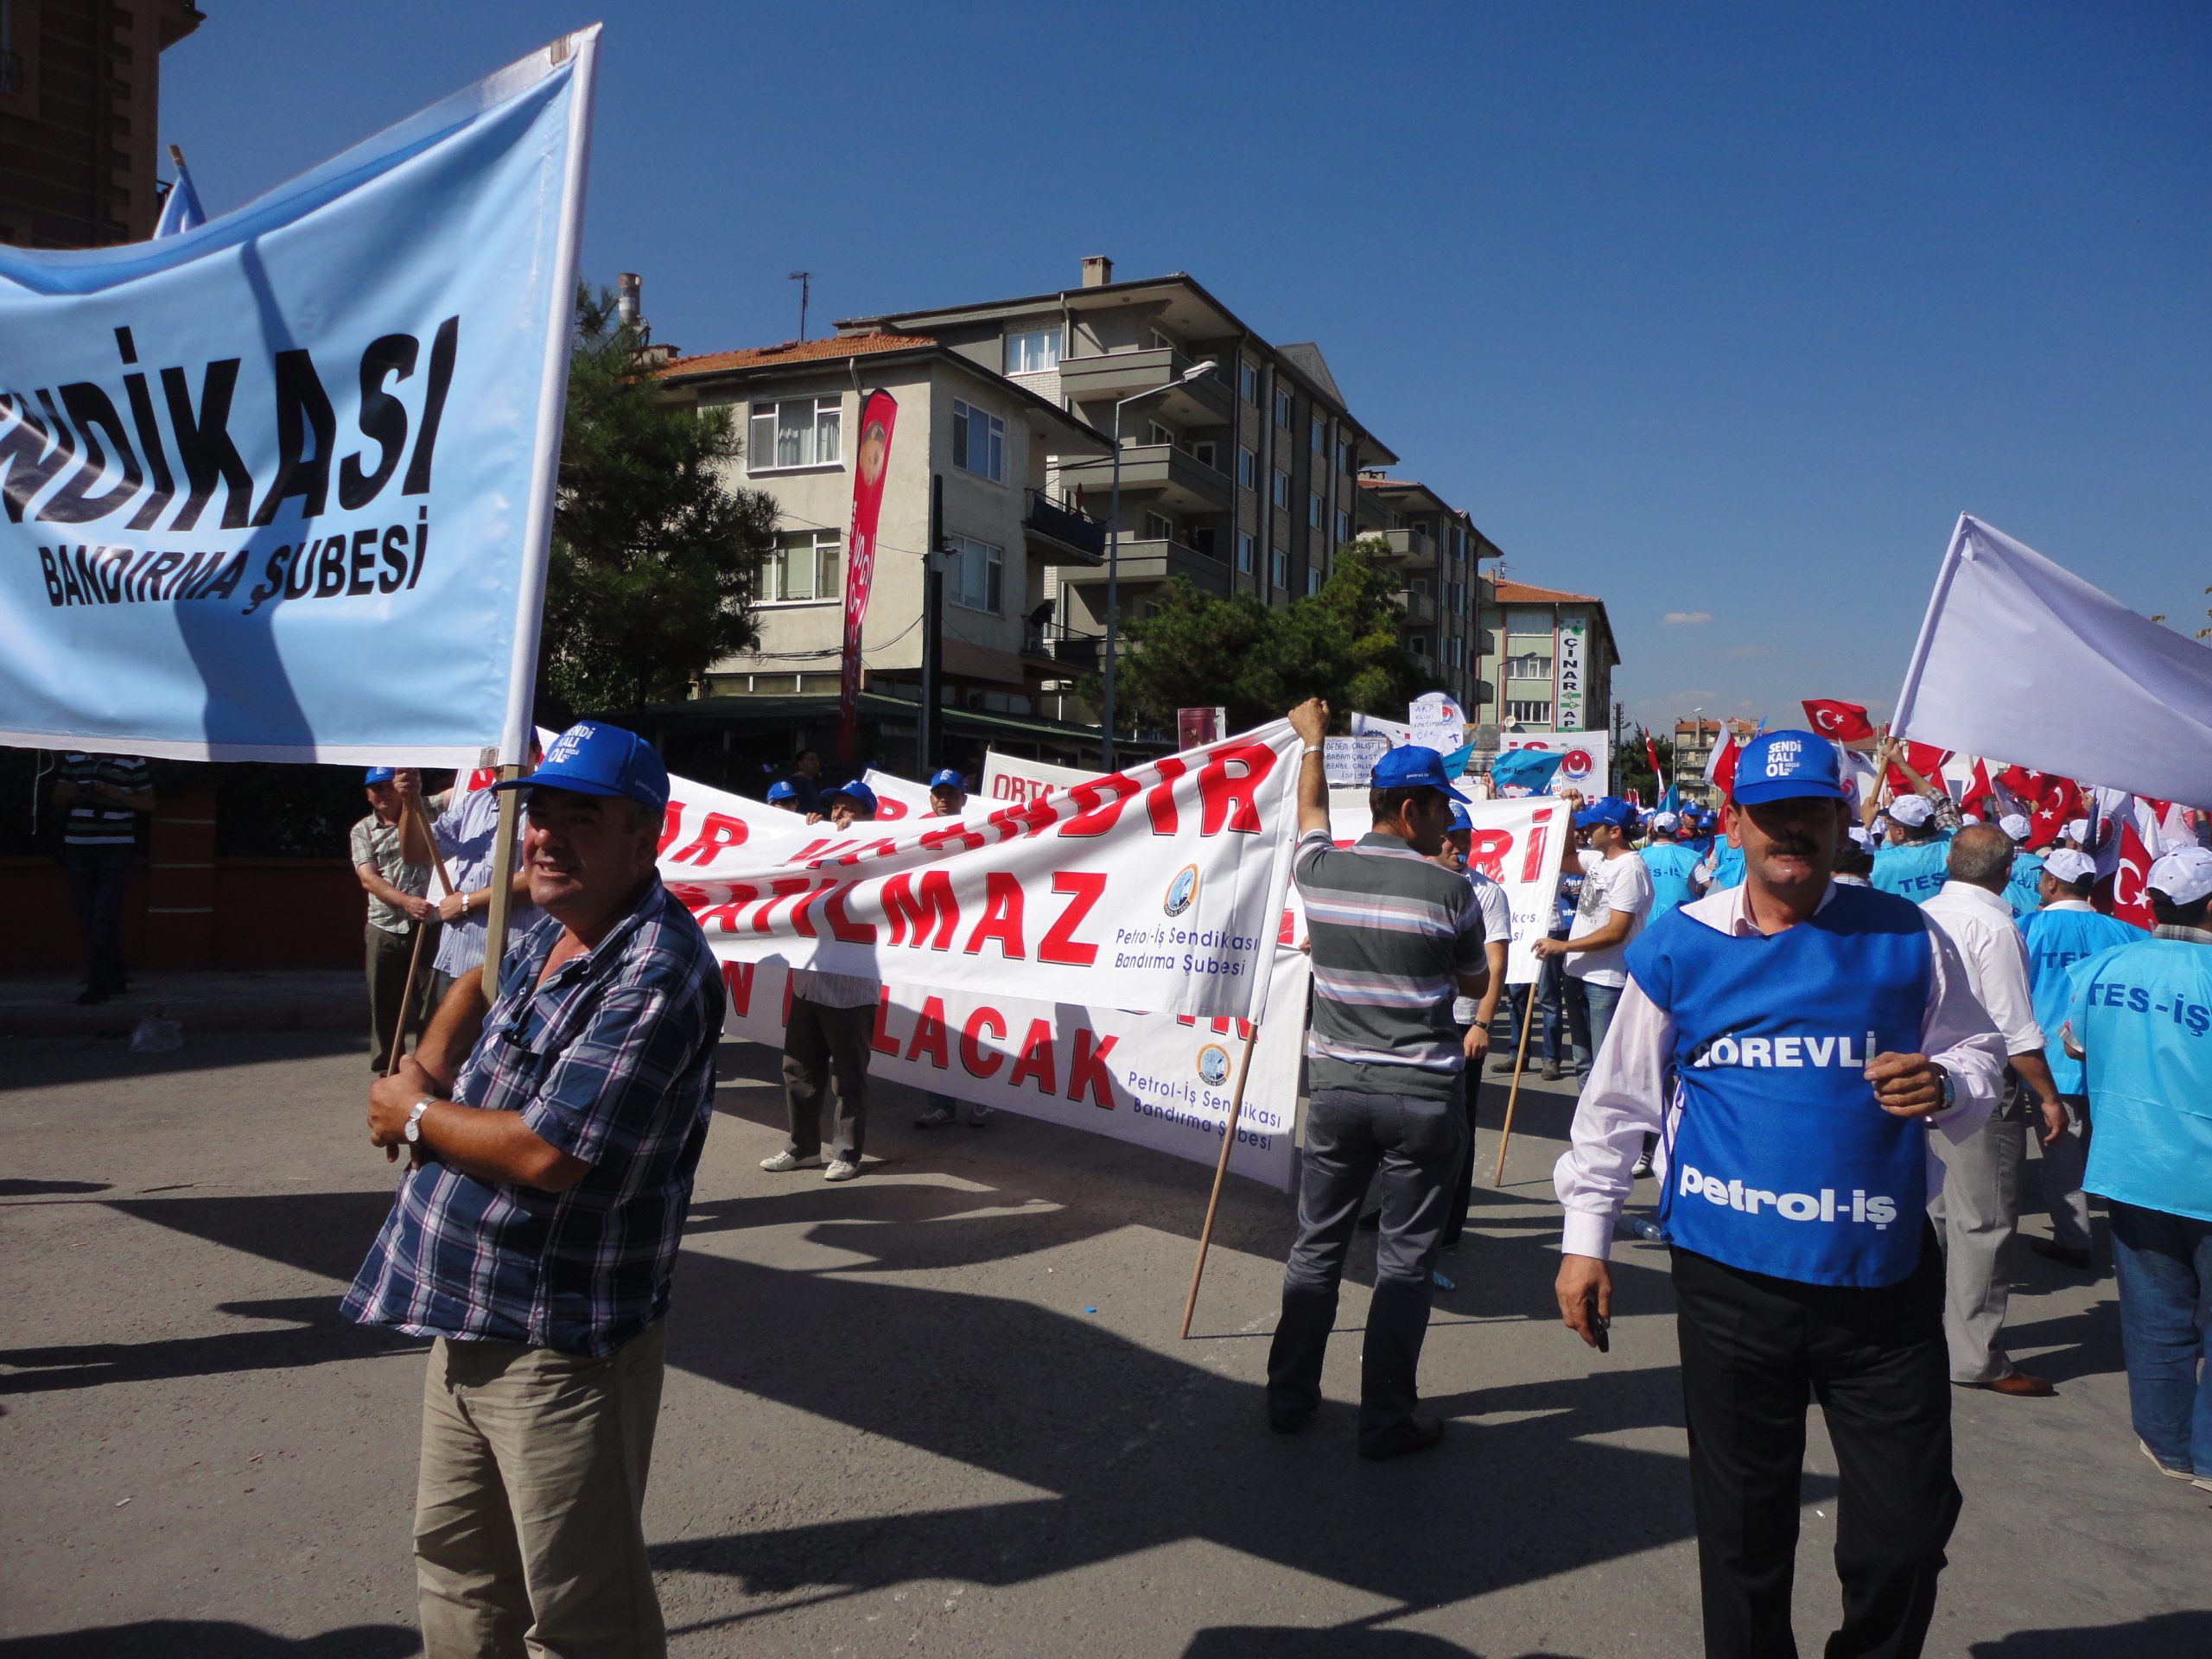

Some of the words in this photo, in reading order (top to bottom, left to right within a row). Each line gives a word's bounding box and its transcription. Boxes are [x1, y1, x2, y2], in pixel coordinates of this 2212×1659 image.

[39, 544, 250, 607] BANDIRMA
[241, 505, 429, 615] ŞUBESİ
[1766, 763, 1789, 777] OL
[1768, 752, 1794, 763] KALI
[1116, 924, 1165, 947] Petrol-İş
[1169, 927, 1258, 951] Sendikası
[1115, 952, 1174, 970] Bandırma
[1183, 954, 1246, 976] Şubesi
[1128, 1071, 1197, 1107] Petrol-İş
[1203, 1090, 1281, 1128] Senikası
[1134, 1097, 1211, 1133] Bandırma
[1218, 1121, 1273, 1151] Şbesi
[1680, 1164, 1897, 1230] petrol-iş
